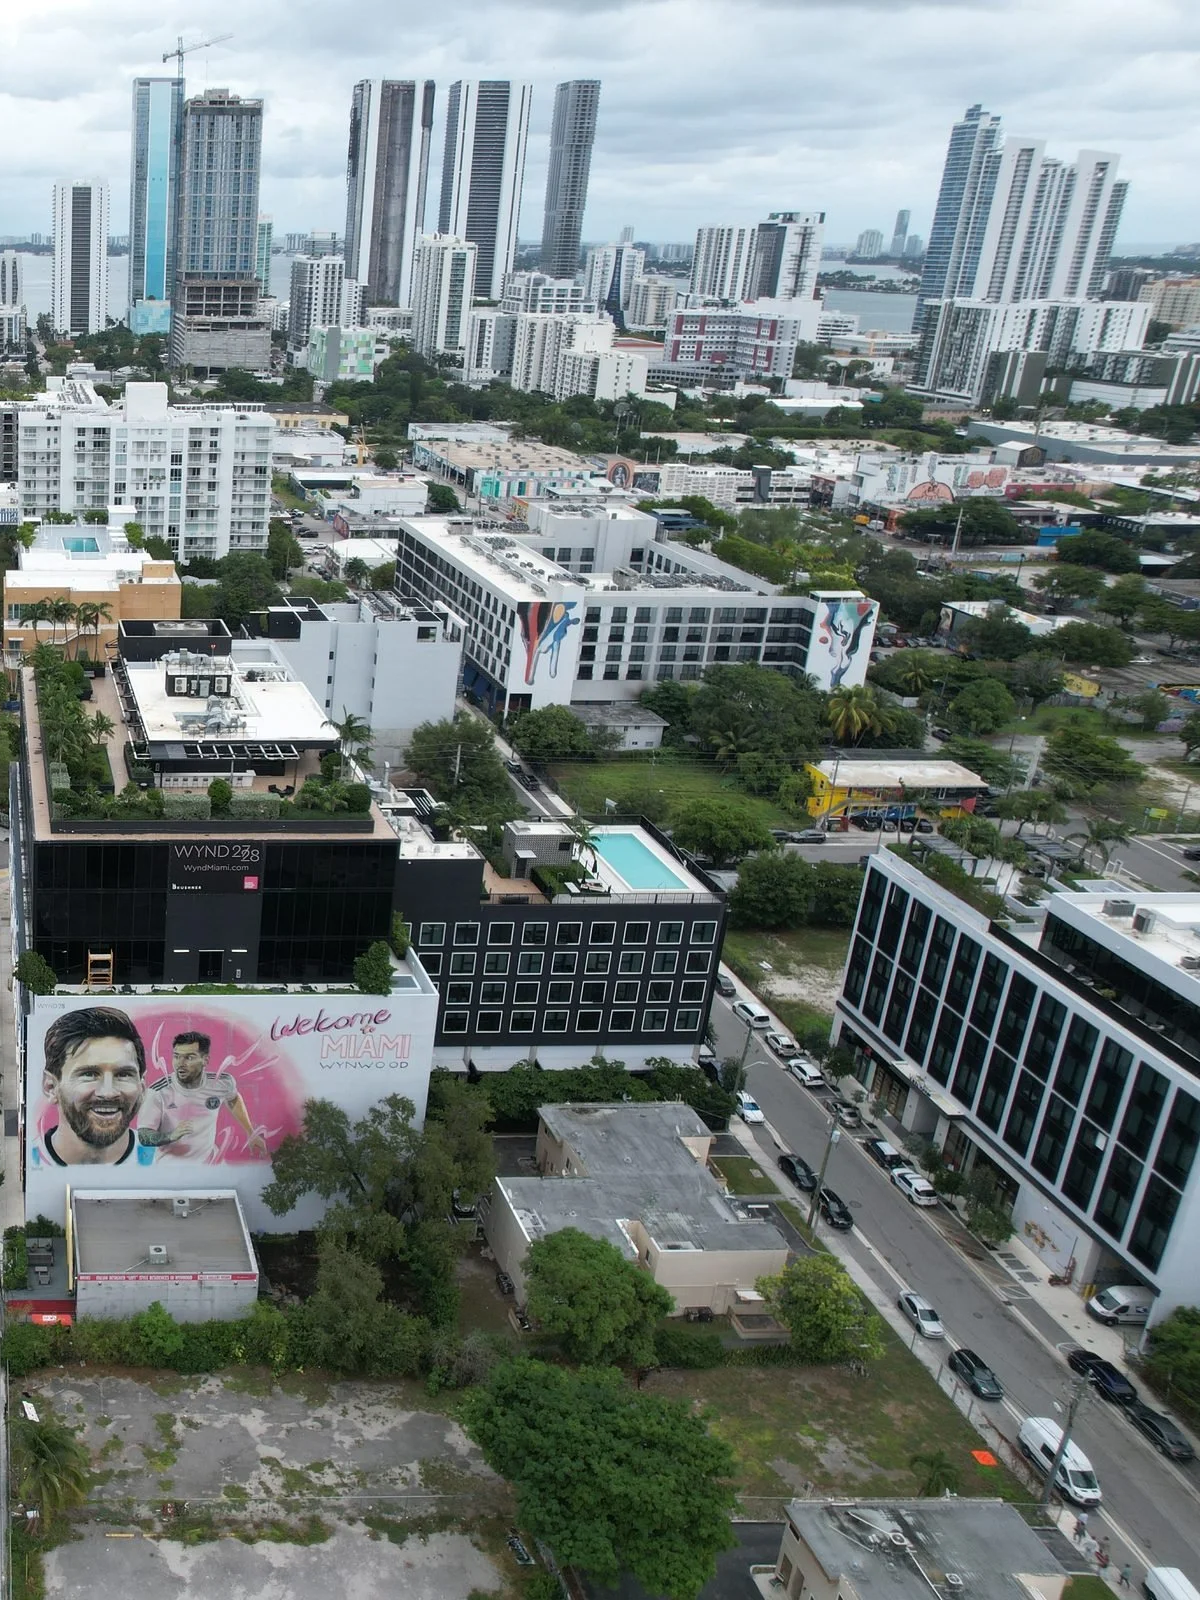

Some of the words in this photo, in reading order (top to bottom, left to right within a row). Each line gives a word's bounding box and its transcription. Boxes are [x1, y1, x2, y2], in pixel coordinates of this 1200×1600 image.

[174, 845, 230, 858] WYND
[183, 864, 250, 873] WyndMiami.com
[270, 1008, 392, 1041] Welcome
[320, 1034, 412, 1059] MIAMI
[319, 1061, 409, 1069] WYNWOOD
